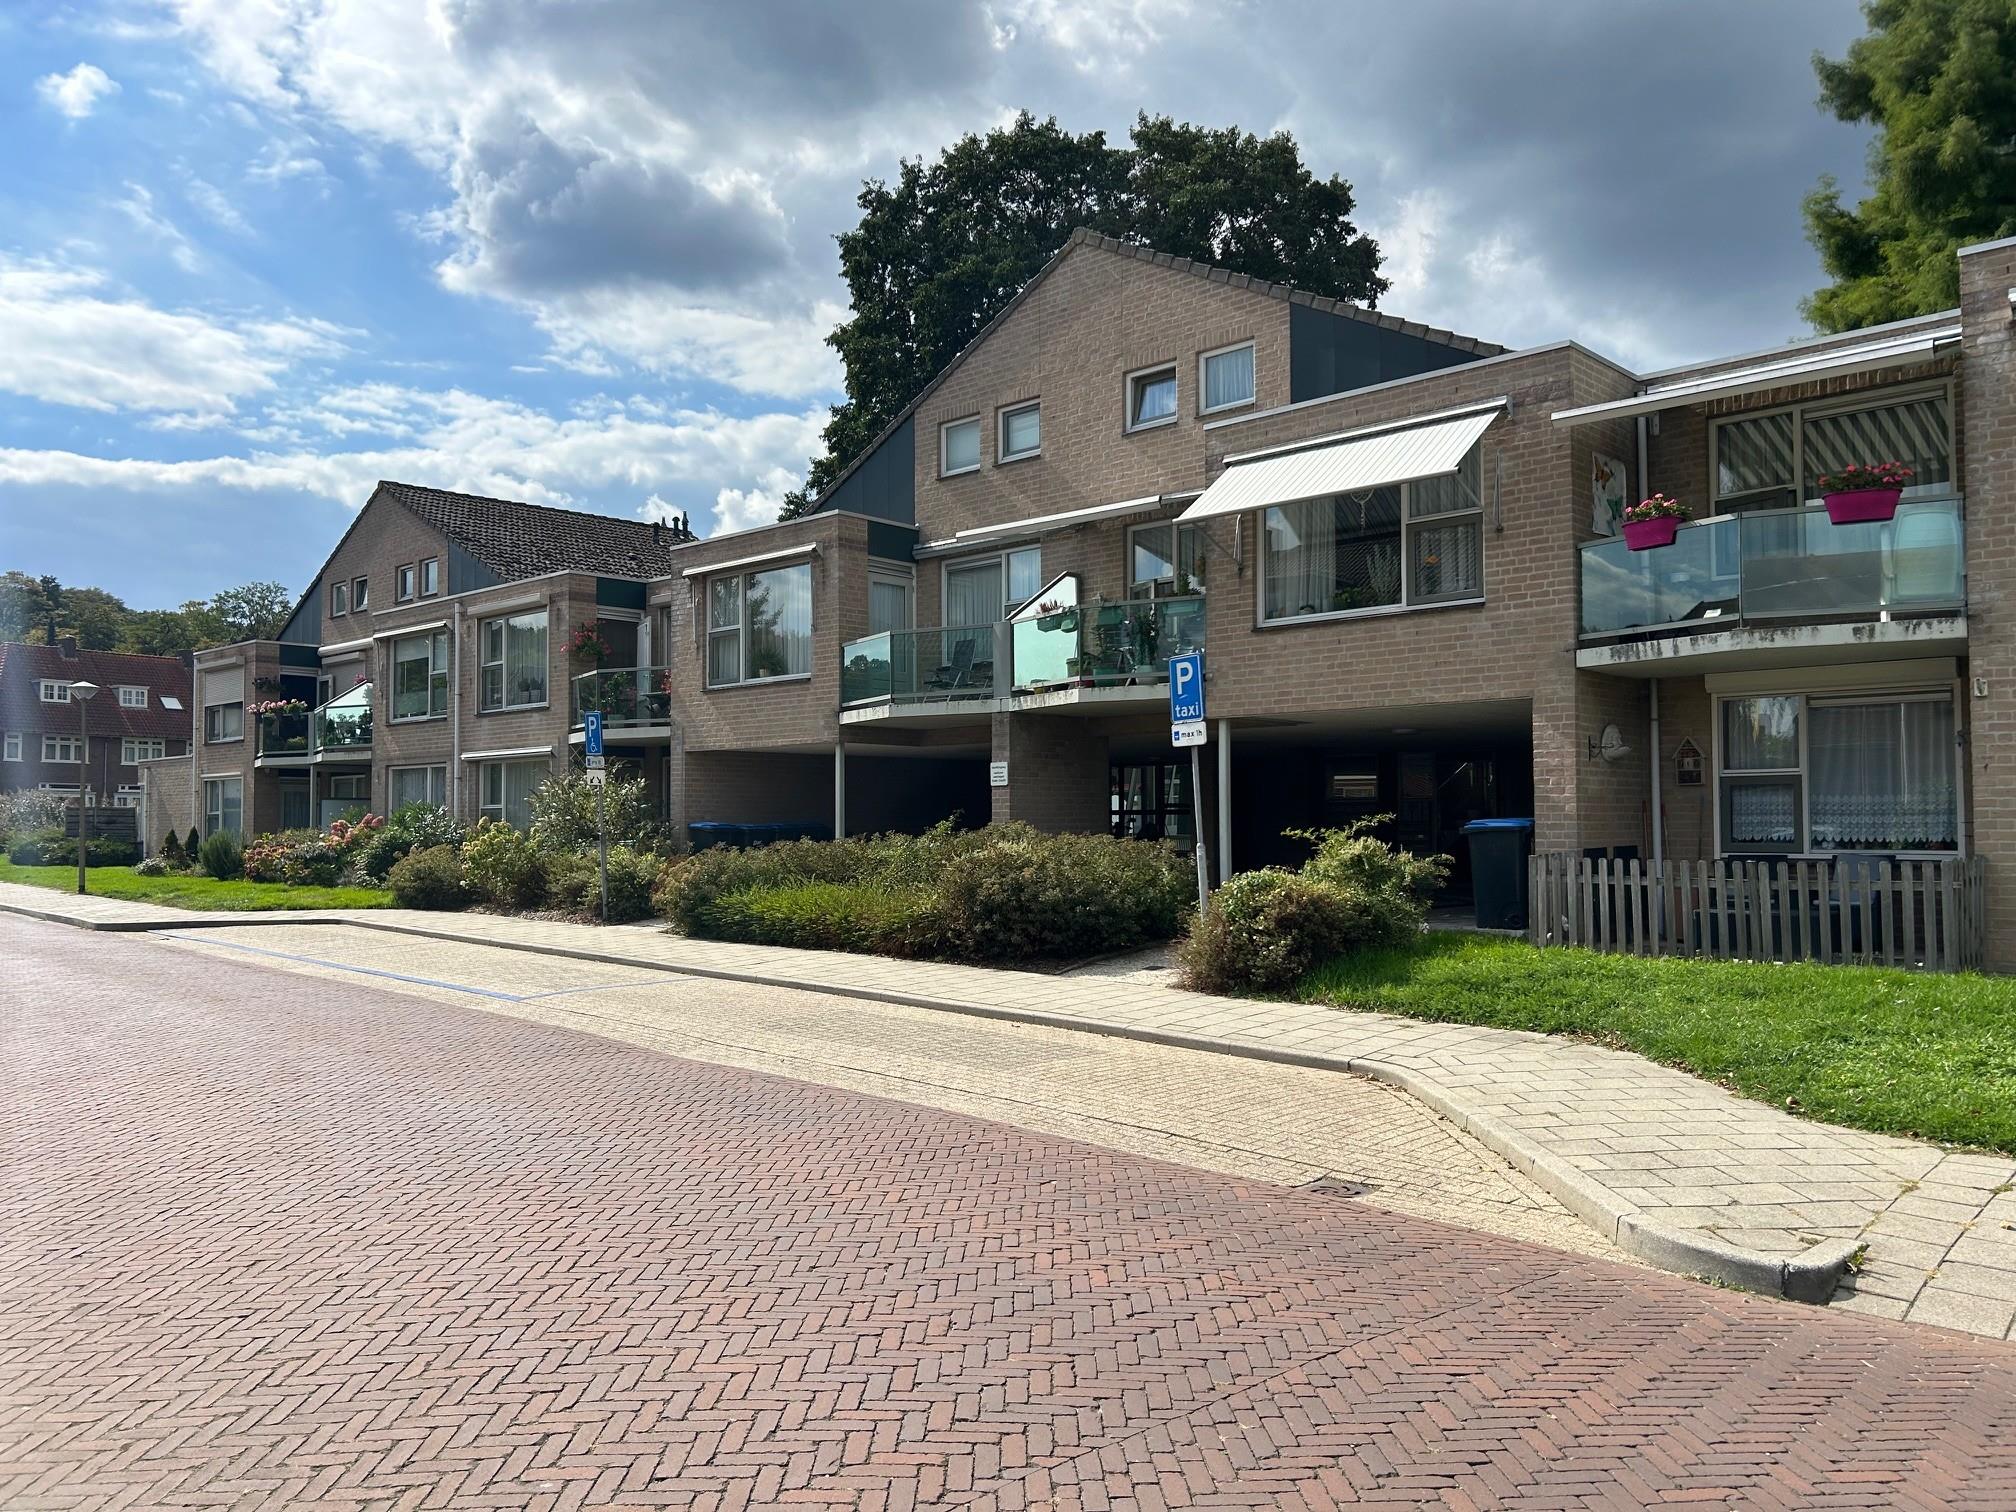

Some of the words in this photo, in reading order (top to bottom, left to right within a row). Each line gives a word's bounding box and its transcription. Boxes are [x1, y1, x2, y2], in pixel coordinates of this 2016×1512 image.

[1176, 662, 1193, 695] P
[1175, 702, 1199, 717] taxi
[589, 716, 597, 737] P
